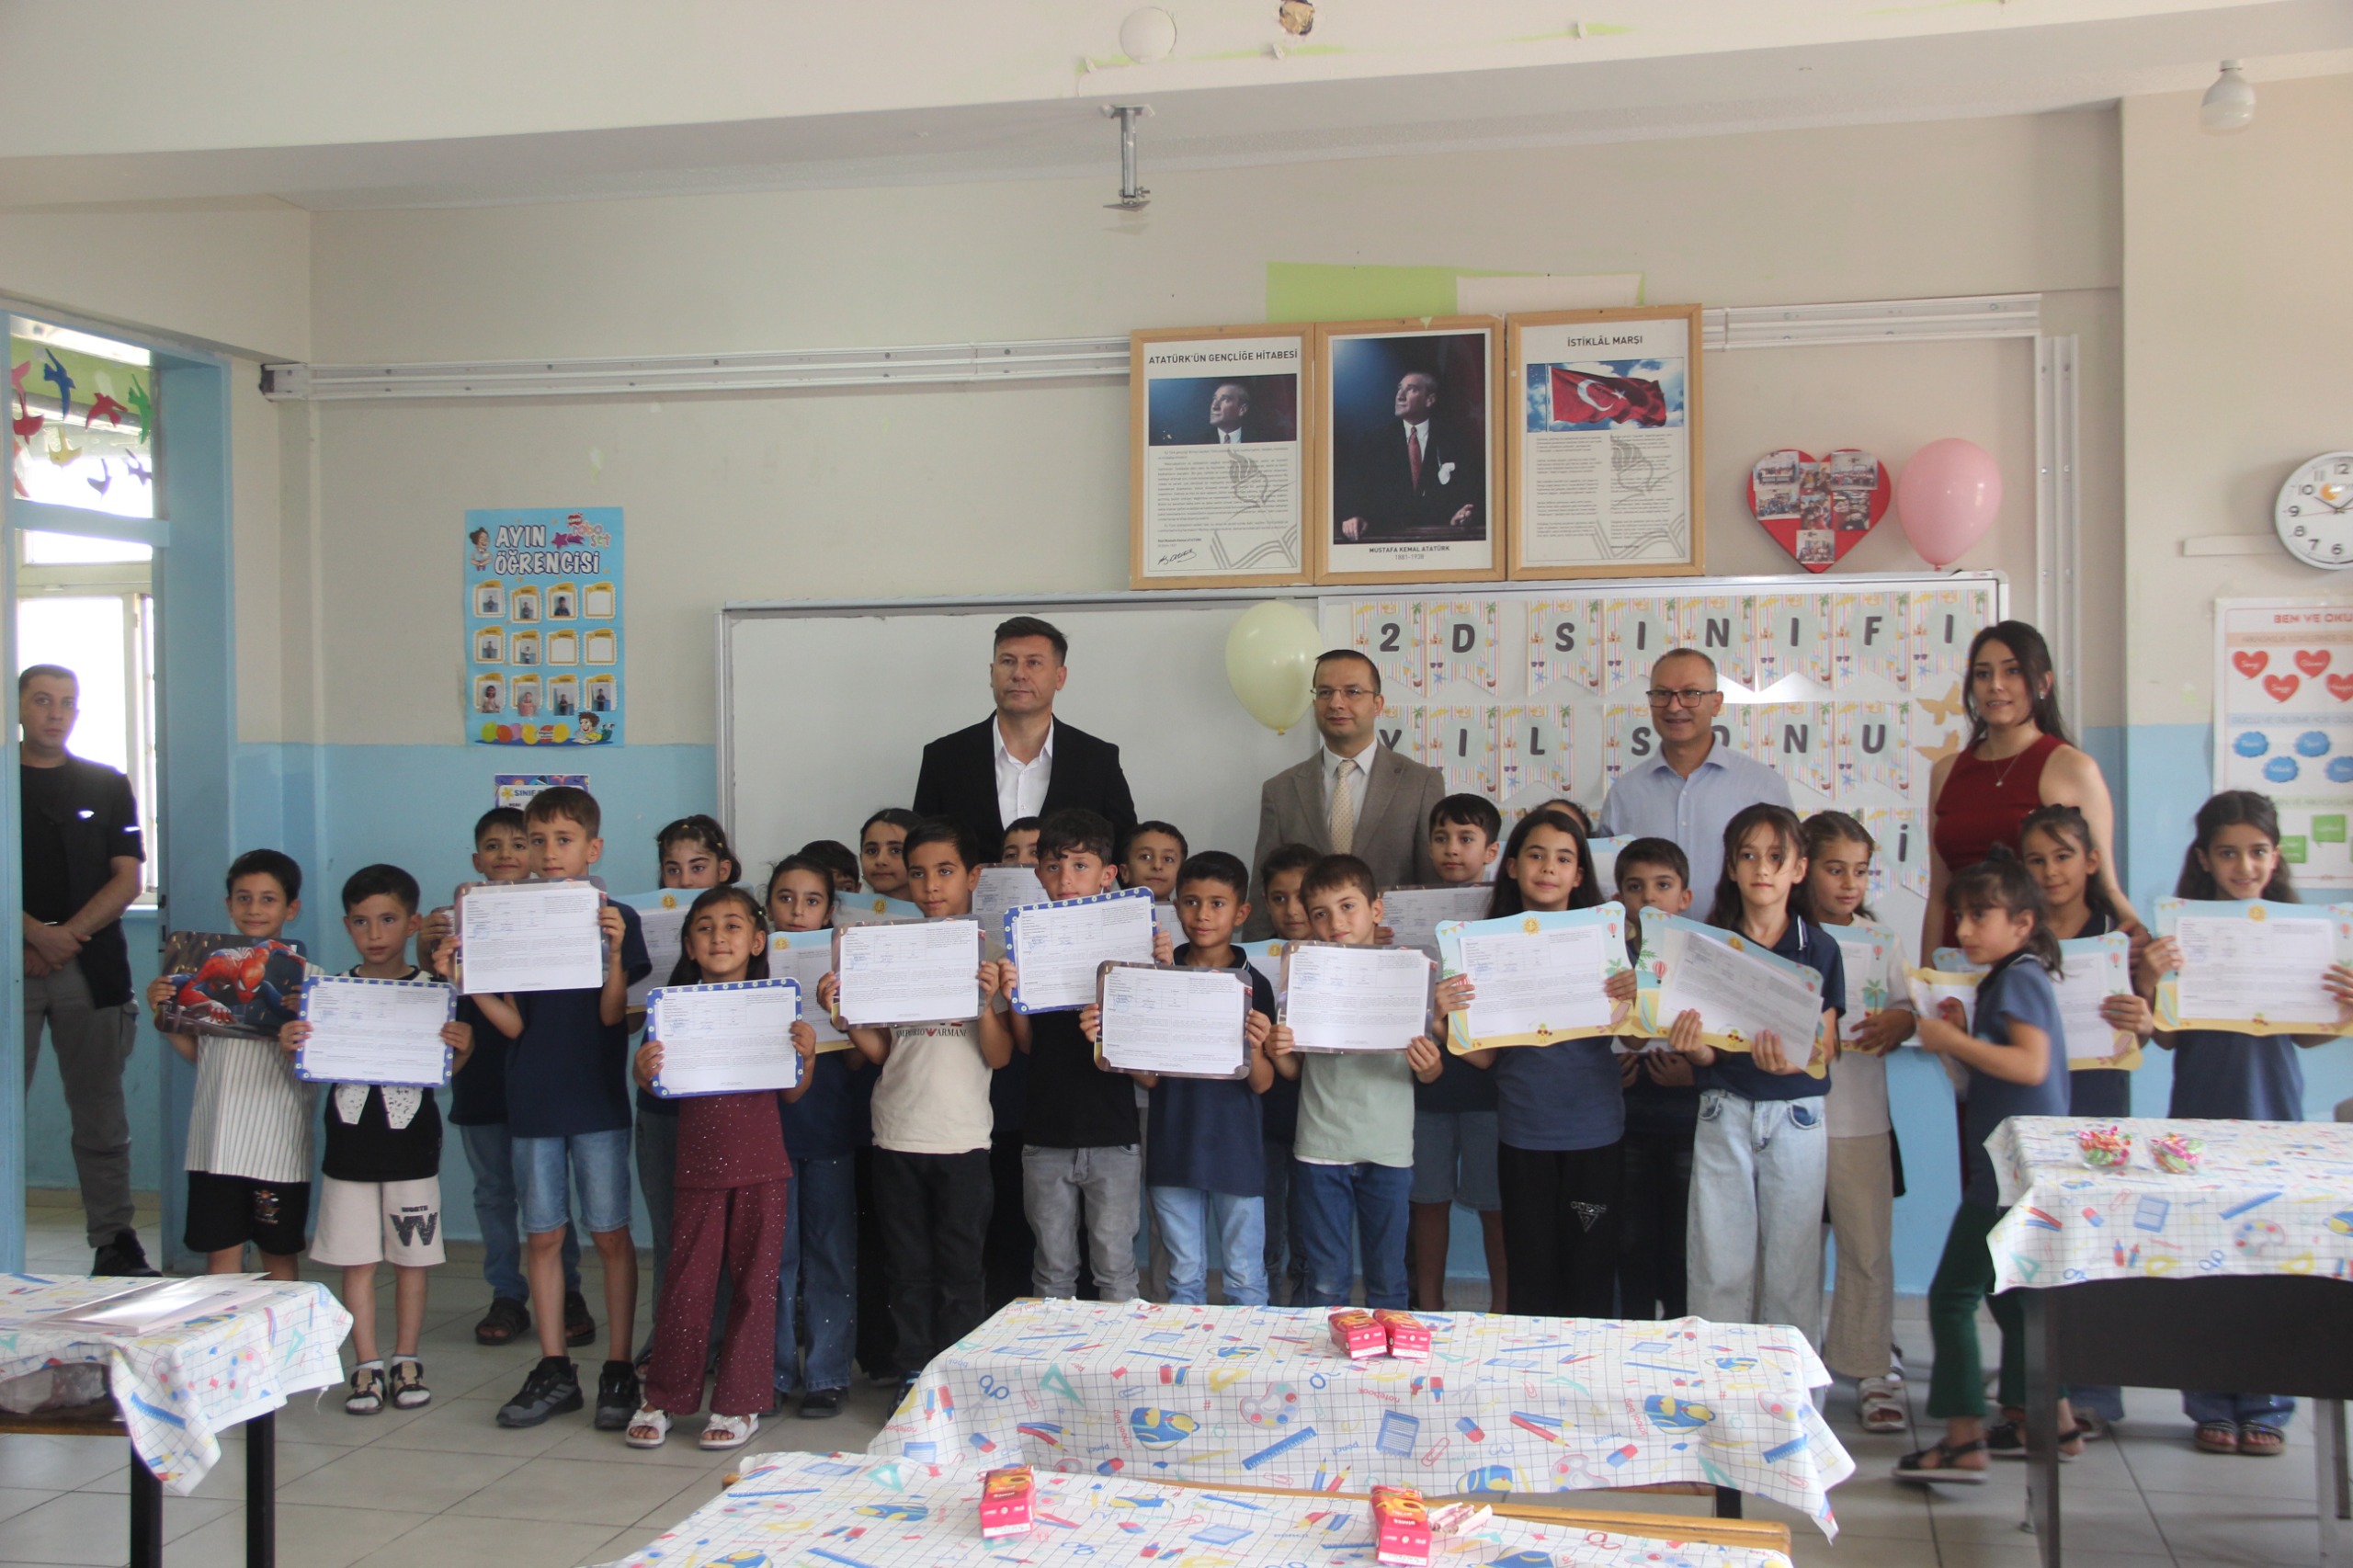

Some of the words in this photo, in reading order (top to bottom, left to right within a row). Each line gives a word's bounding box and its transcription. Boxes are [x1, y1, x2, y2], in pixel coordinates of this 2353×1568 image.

[1567, 335, 1609, 347] İSTİKLÂL
[1612, 335, 1643, 345] MARŞI
[1148, 353, 1206, 364] ATATÜRK'ÜN
[1209, 350, 1254, 363] GENÇLİĞE
[1256, 348, 1298, 360] HİTABESİ
[2288, 506, 2300, 517] 9
[494, 525, 547, 548] AYIN
[2294, 525, 2305, 537] 8
[2308, 539, 2320, 551] 7
[2331, 543, 2343, 555] 6
[494, 549, 600, 575] ÖĞRENCİSİ
[2303, 613, 2321, 623] VE
[936, 1028, 967, 1037] ARMANI
